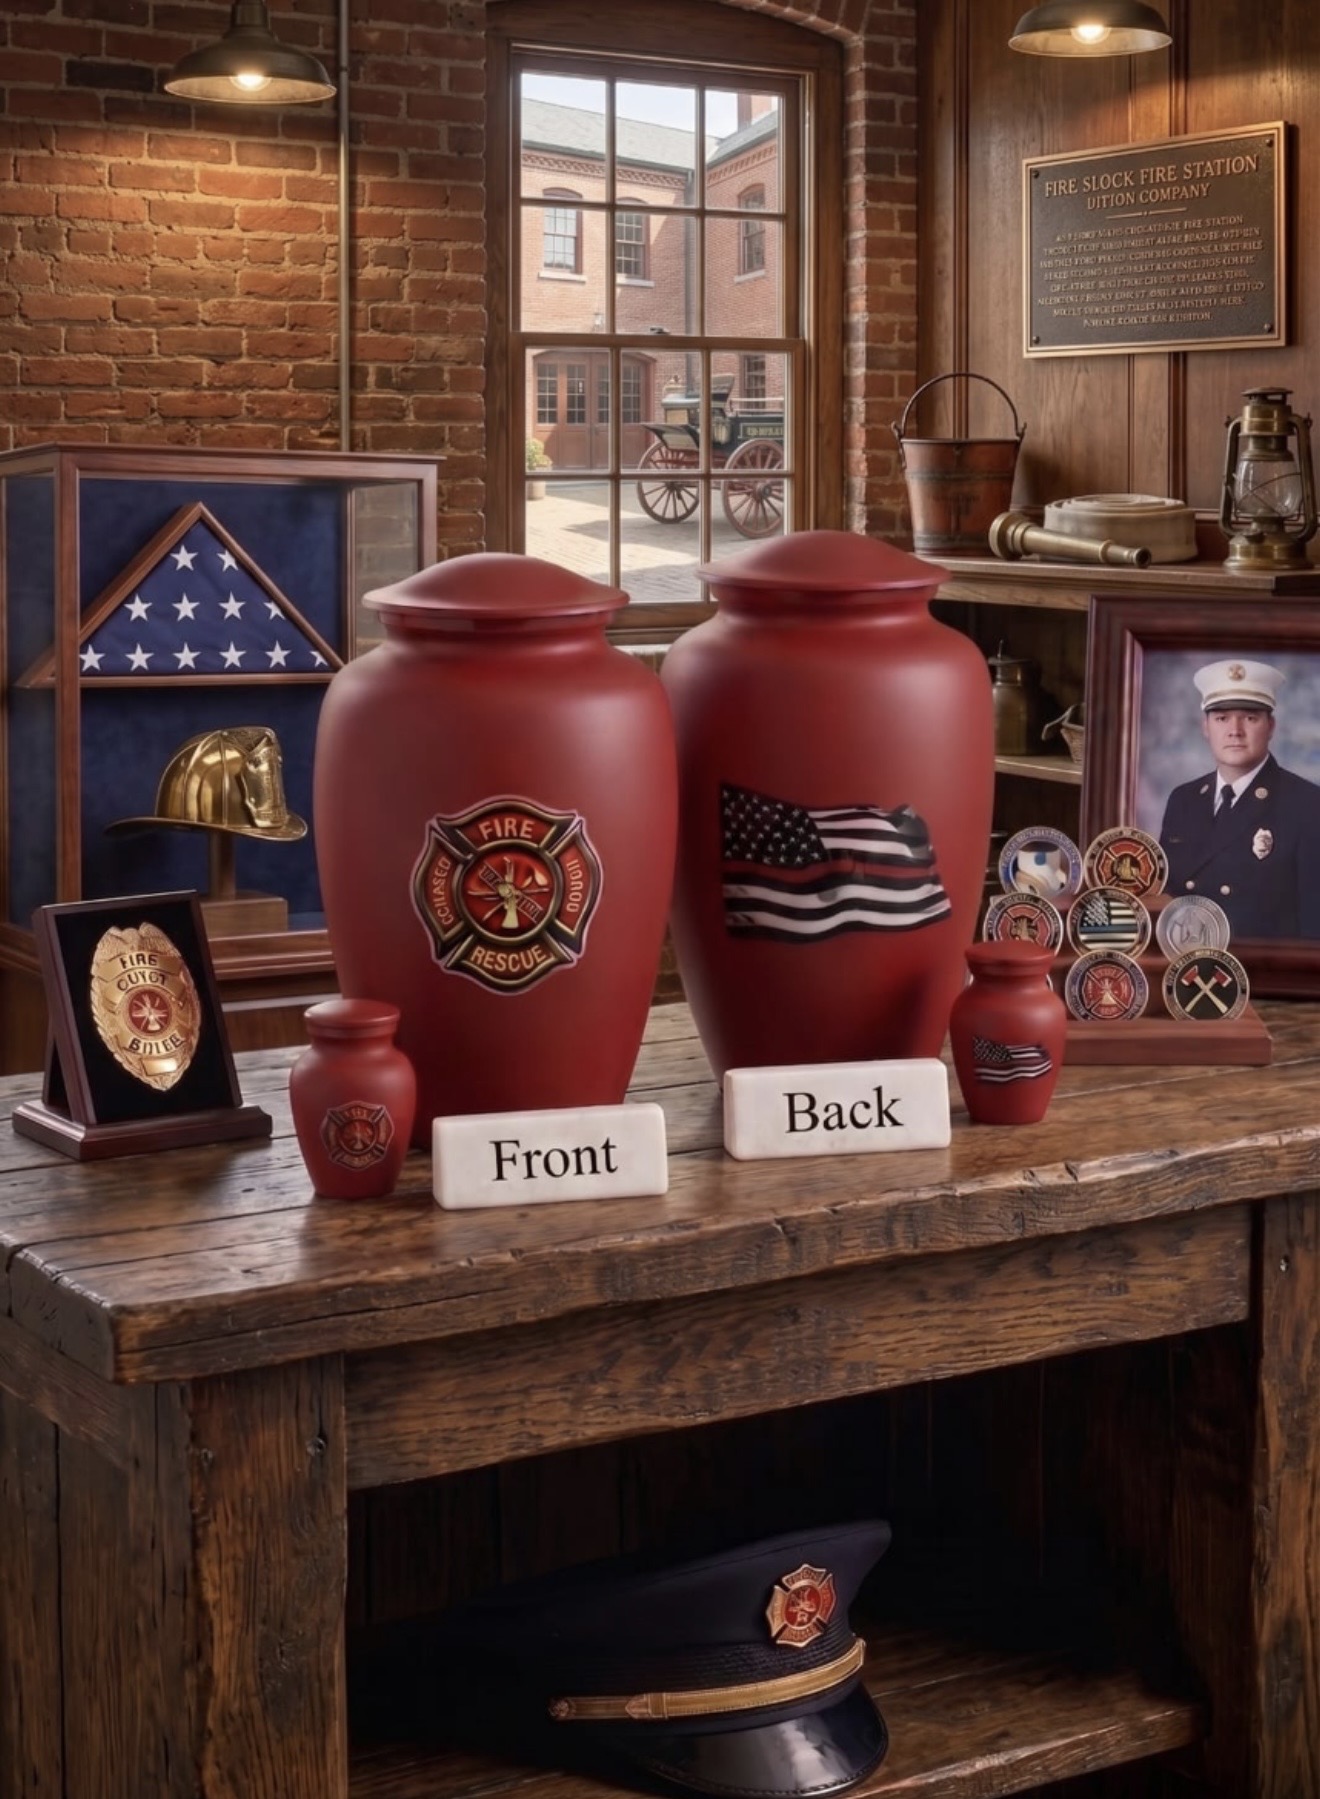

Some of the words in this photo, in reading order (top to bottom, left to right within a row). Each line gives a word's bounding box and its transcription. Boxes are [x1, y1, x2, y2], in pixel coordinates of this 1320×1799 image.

[1045, 179, 1078, 198] FIRE
[1083, 171, 1134, 192] SLOCK
[1140, 165, 1178, 185] FIRE
[1183, 154, 1259, 180] STATION
[1139, 183, 1211, 204] COMPANY
[478, 817, 535, 841] FIRE
[120, 952, 158, 969] FIRE
[471, 945, 547, 972] RESCUE
[783, 1085, 904, 1134] Back
[490, 1137, 618, 1182] Front
